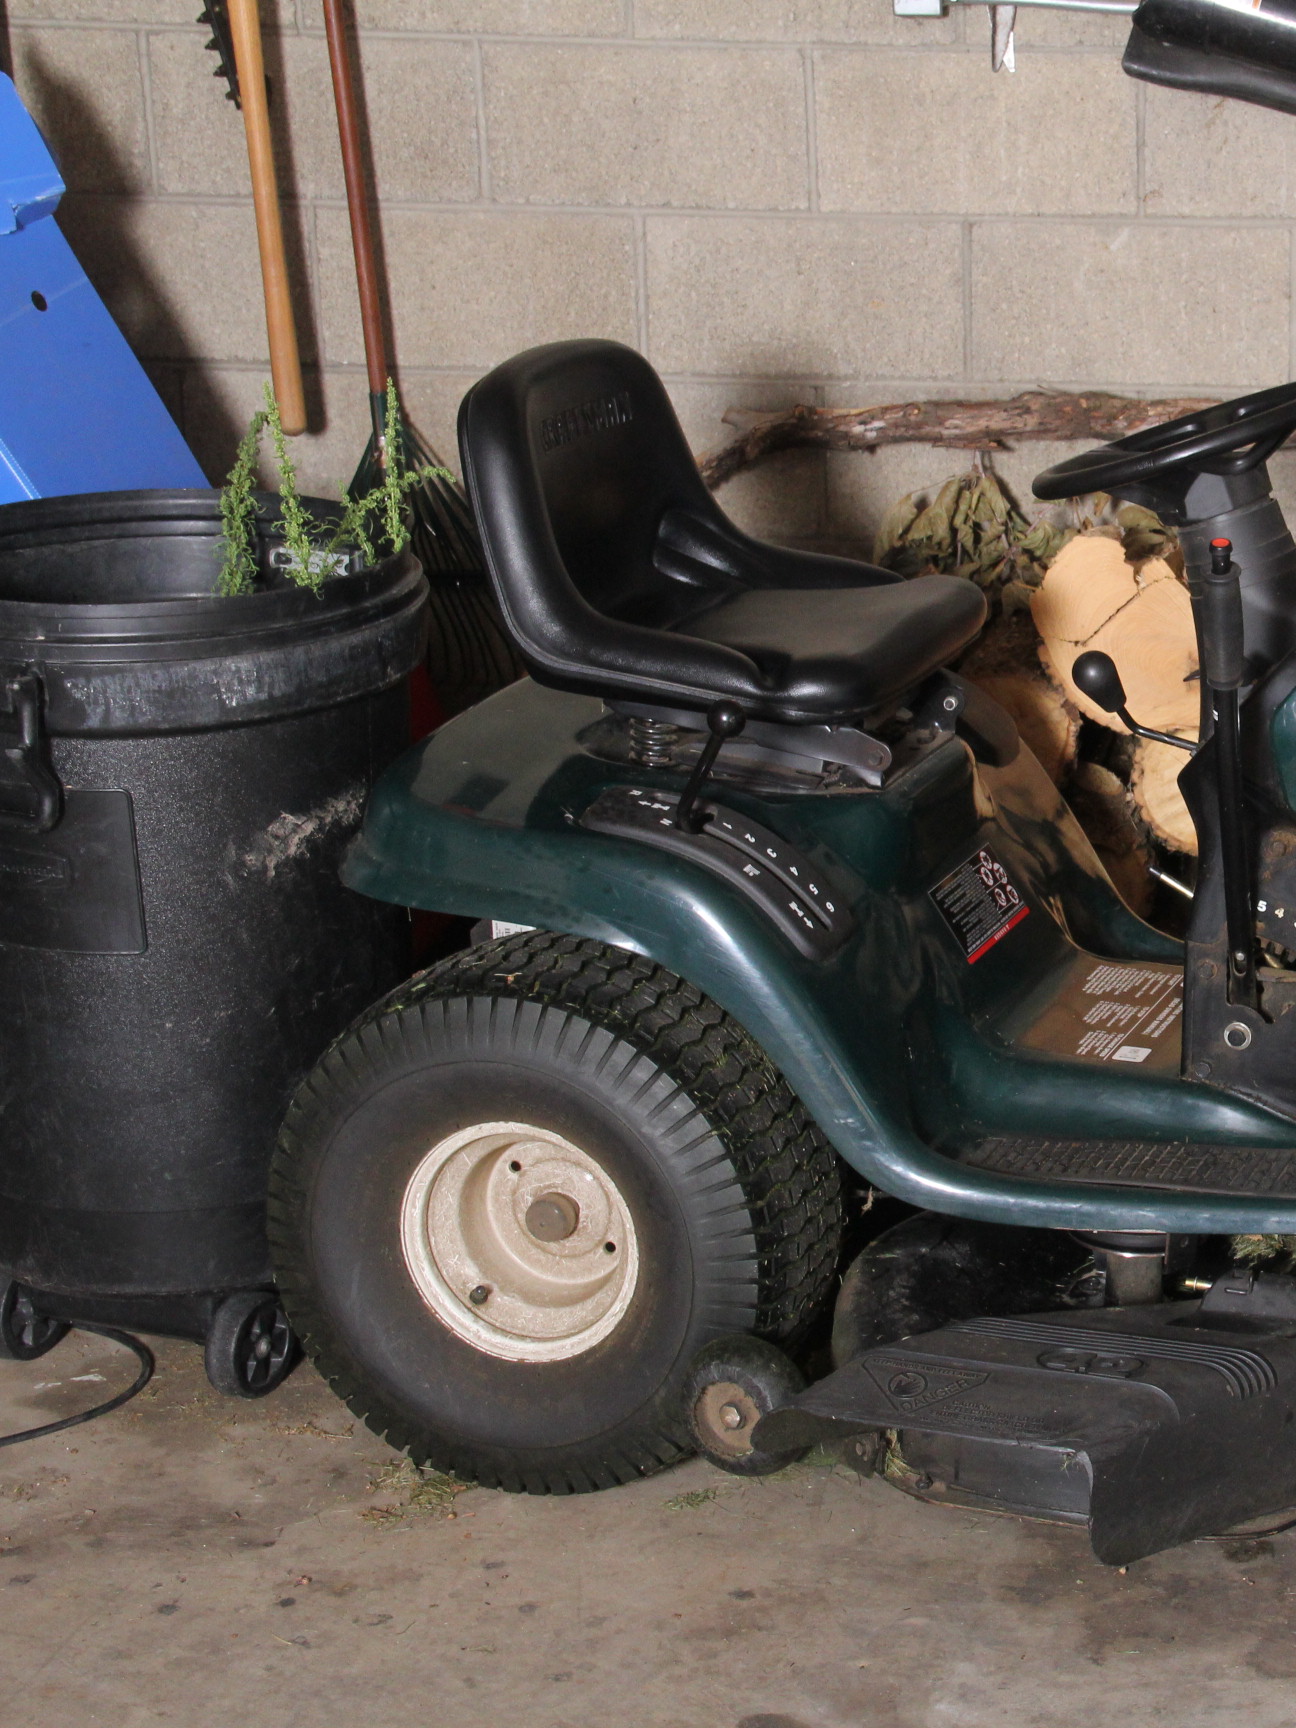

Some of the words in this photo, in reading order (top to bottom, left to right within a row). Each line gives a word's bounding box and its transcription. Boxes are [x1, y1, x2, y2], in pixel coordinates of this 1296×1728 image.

[722, 821, 734, 830] 1
[744, 832, 756, 844] 2
[766, 847, 778, 859] 3
[788, 865, 800, 877] 4
[808, 883, 819, 896] 5
[825, 901, 835, 914] 6
[1256, 899, 1268, 913] 5
[1273, 906, 1285, 920] 4
[900, 1379, 970, 1412] DANGER
